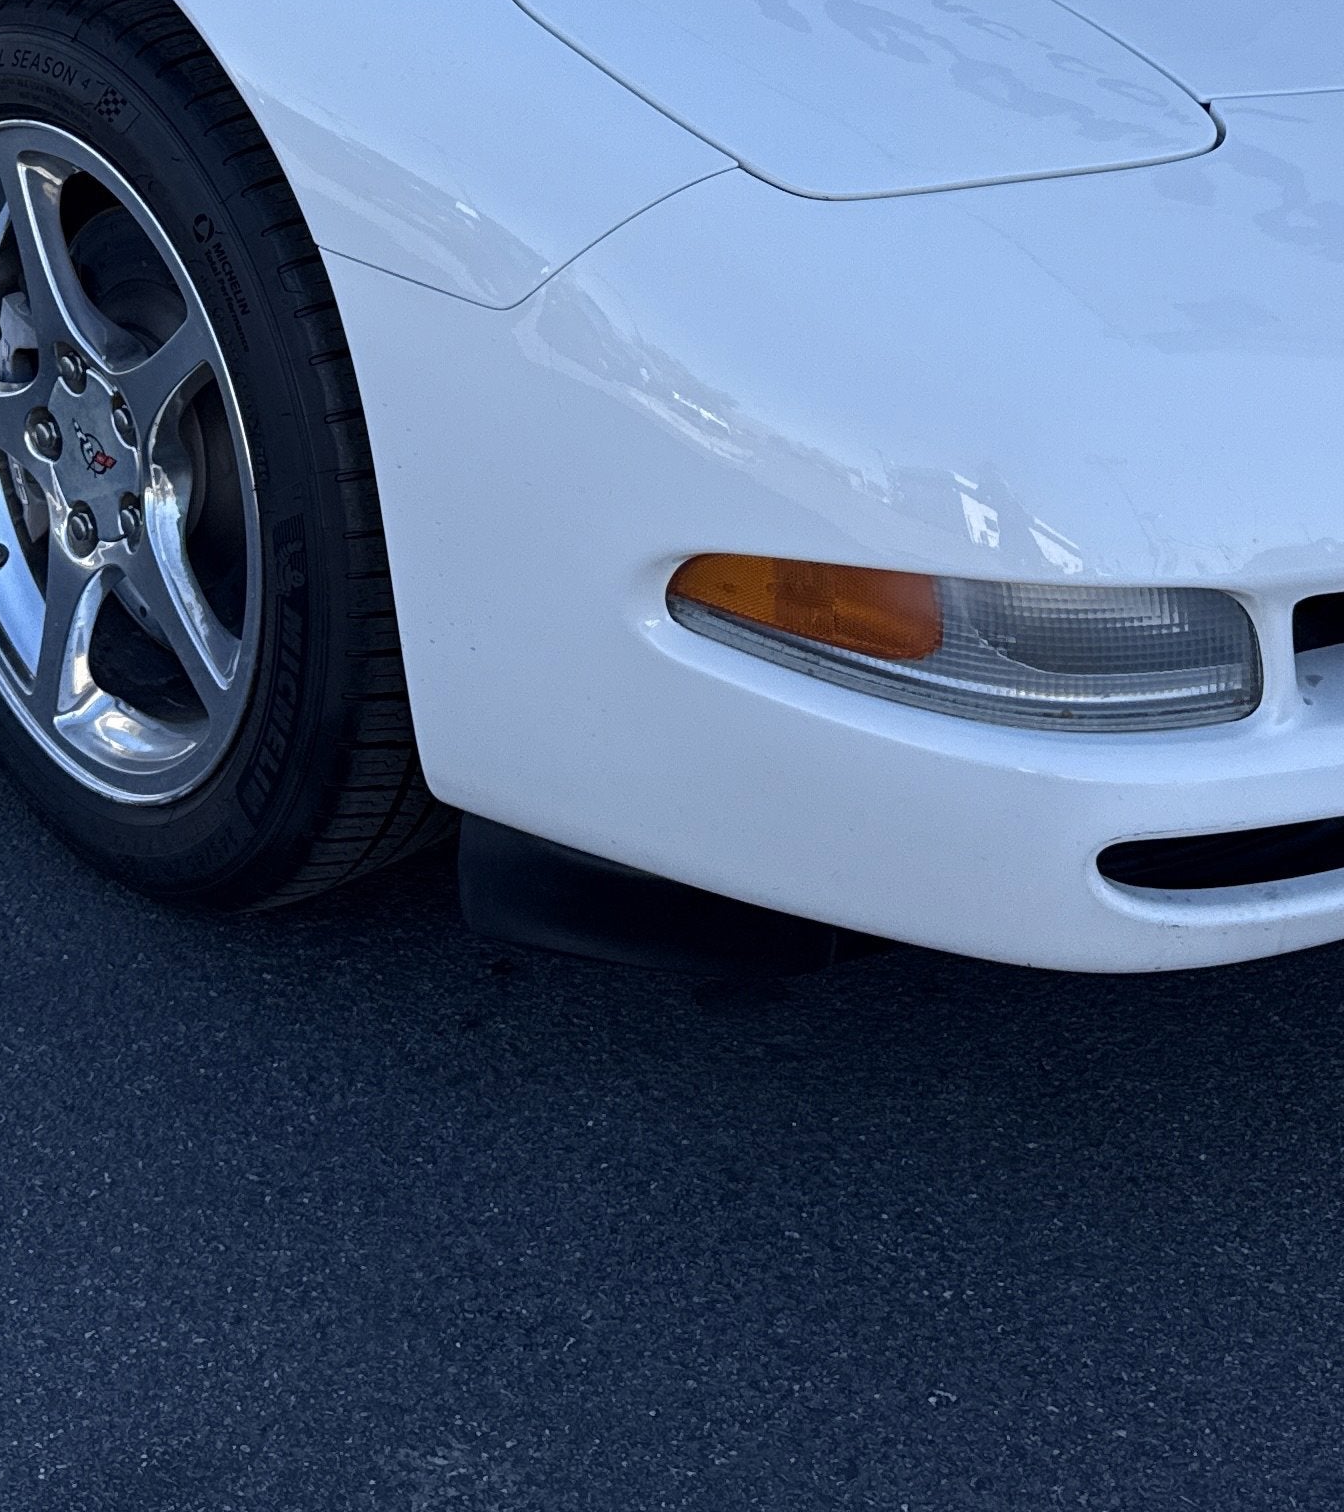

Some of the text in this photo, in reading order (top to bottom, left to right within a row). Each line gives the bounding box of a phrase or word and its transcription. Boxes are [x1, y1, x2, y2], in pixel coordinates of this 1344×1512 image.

[10, 48, 78, 87] SEASON
[203, 248, 251, 354] Total Performance
[211, 241, 252, 317] MICHELIN
